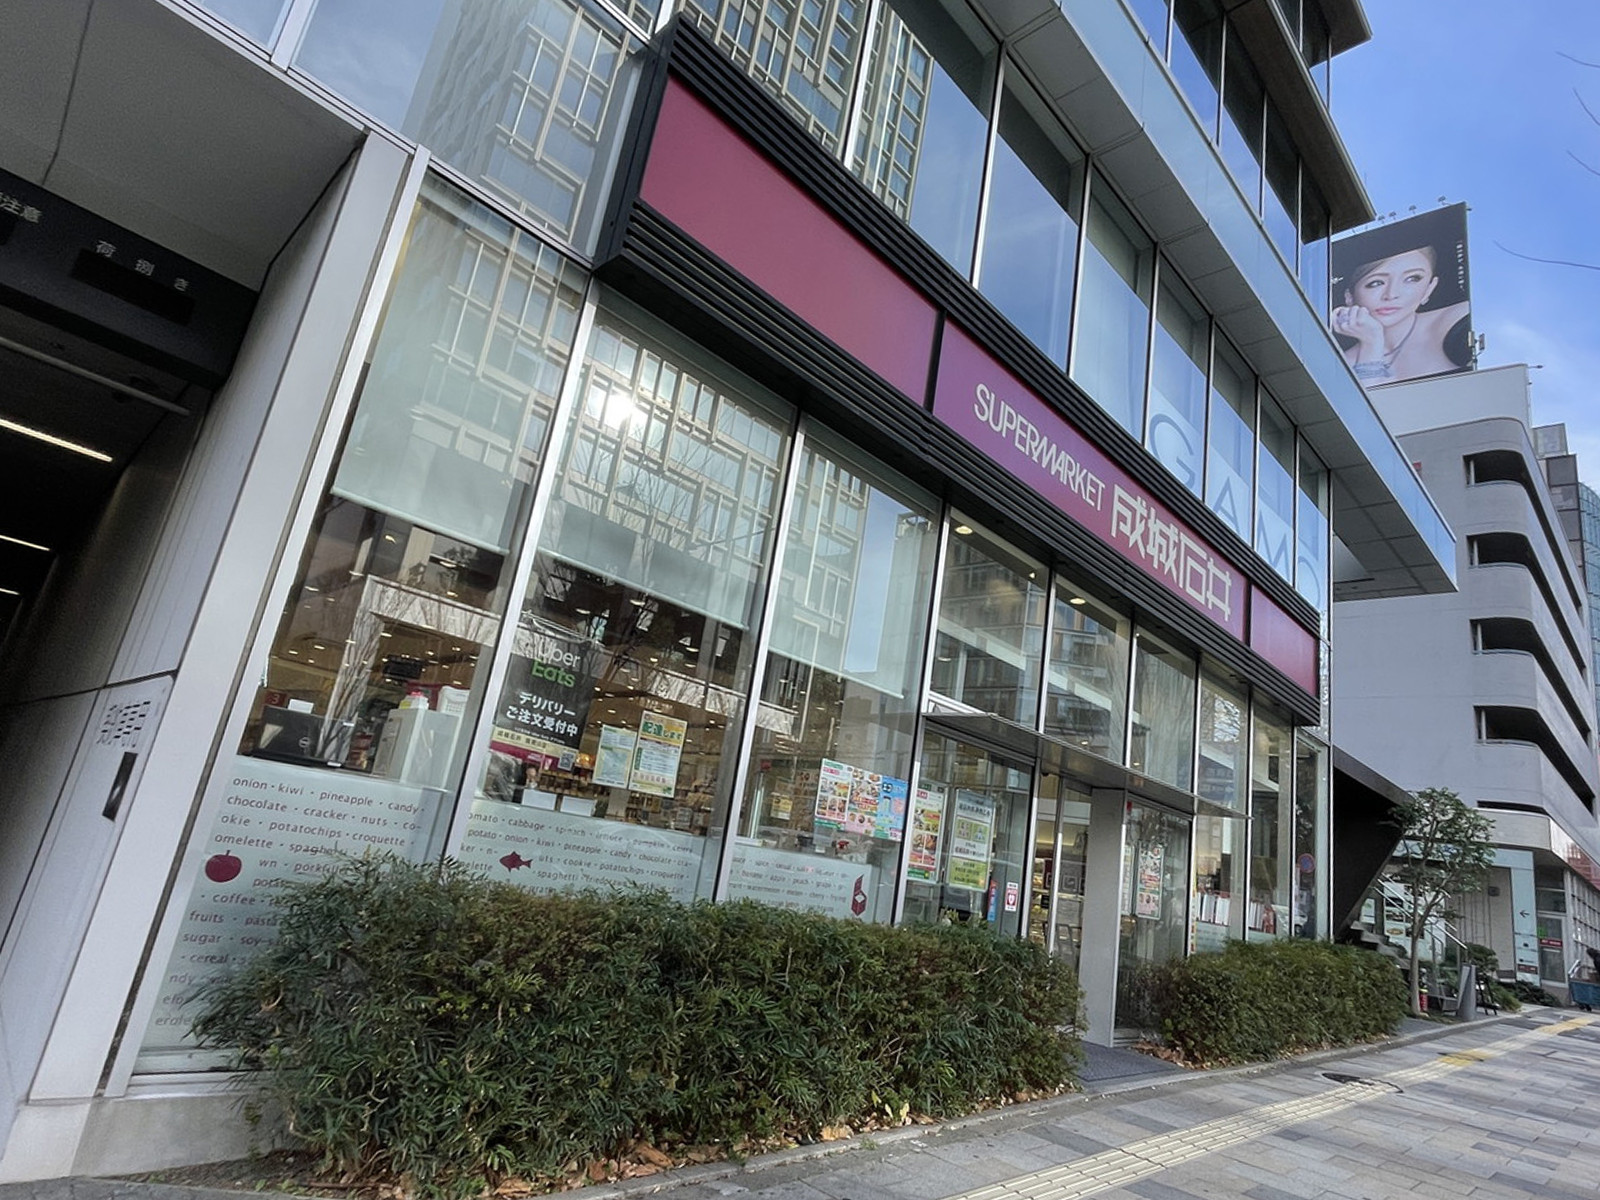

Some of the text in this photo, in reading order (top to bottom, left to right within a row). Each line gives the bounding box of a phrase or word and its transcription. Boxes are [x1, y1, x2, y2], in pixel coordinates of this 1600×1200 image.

[973, 383, 1232, 621] SUPERMARKET 成城石井
[532, 660, 576, 687] Eats
[519, 691, 576, 717] デリバリー
[506, 705, 579, 737] ご注文受付中
[233, 777, 419, 815] onion kiwi pineapple candy
[227, 794, 288, 812] chocolate
[303, 806, 349, 821] cracker
[360, 816, 388, 827] nuts
[221, 814, 406, 847] okie potatochips croquette
[508, 818, 545, 831] cabbage
[214, 834, 273, 849] omelette
[467, 828, 497, 840] potato
[504, 833, 529, 844] onion
[212, 892, 256, 906] coffee
[189, 910, 224, 925] fruits
[182, 932, 222, 945] sugar
[189, 953, 229, 964] cereal
